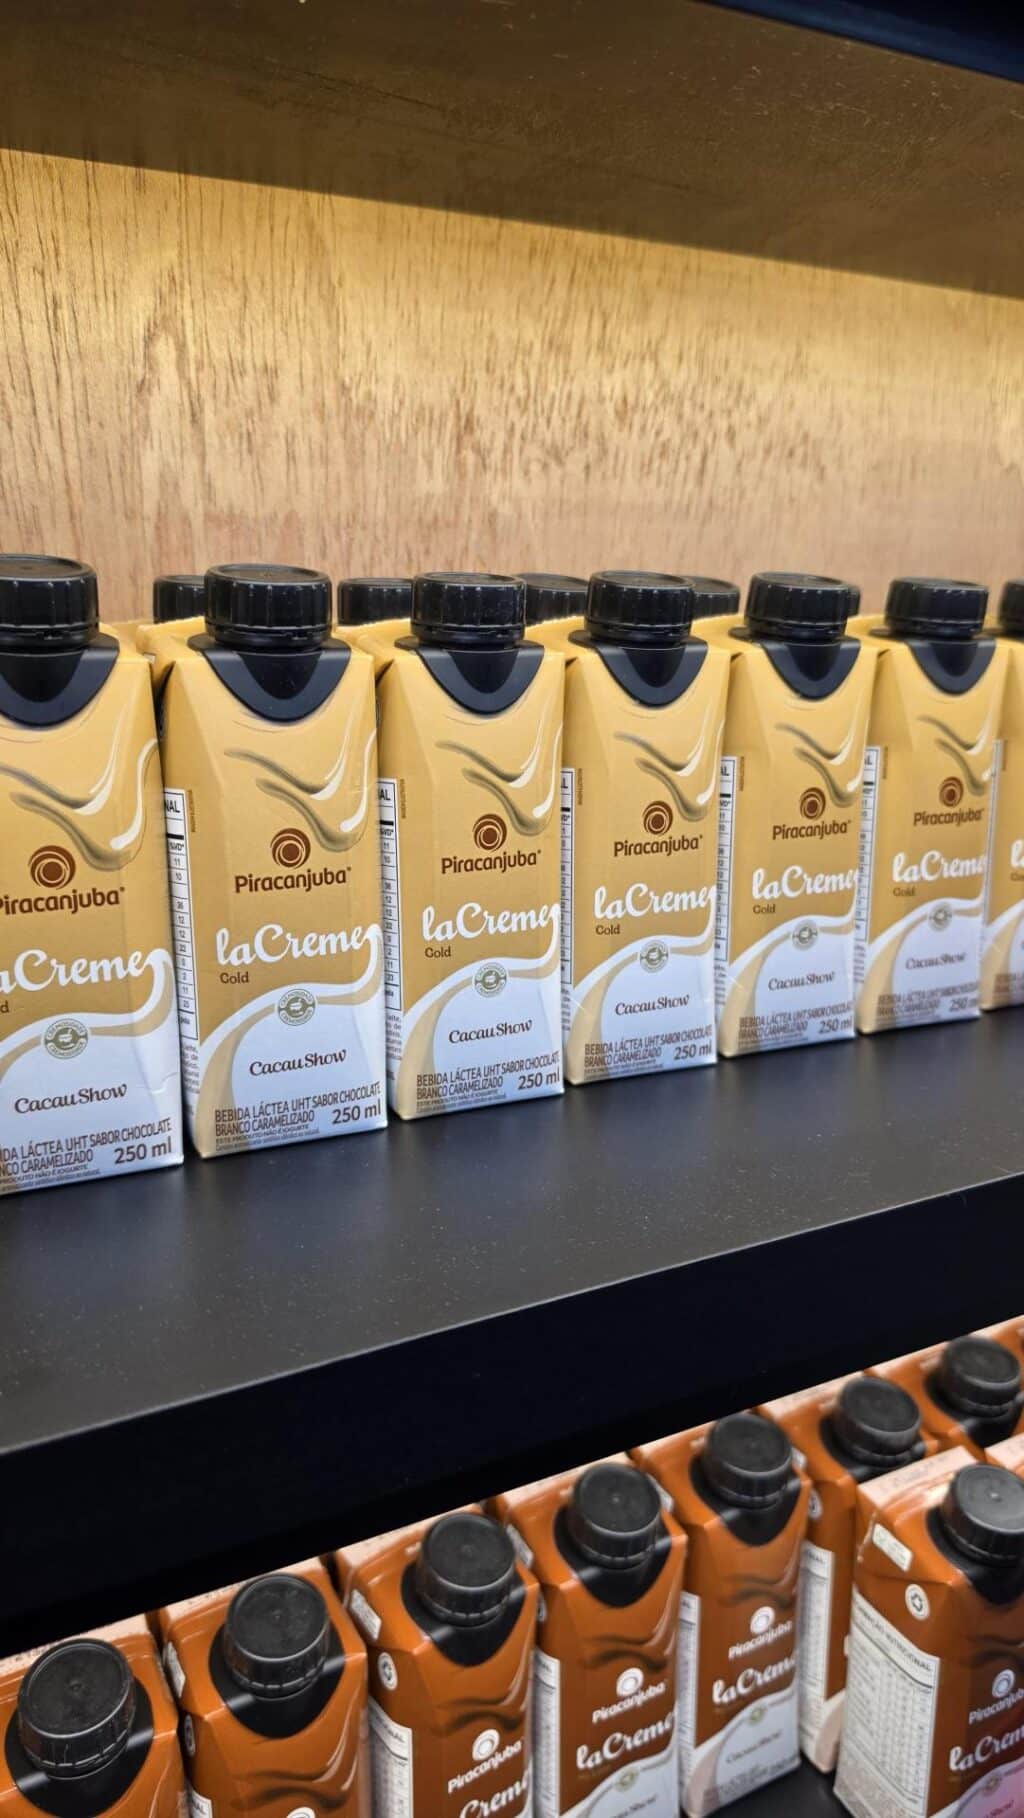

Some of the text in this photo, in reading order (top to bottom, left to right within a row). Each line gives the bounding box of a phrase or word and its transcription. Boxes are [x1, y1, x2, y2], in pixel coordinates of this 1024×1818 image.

[772, 820, 848, 840] Piracanjuba
[613, 834, 699, 857] Piracanjuba
[441, 850, 537, 874] Piracanjuba
[235, 868, 347, 893] Piracanjuba
[0, 887, 120, 915] iracanjuba
[594, 883, 709, 919] laCreme
[753, 904, 775, 914] Gold
[422, 902, 551, 941] laCreme
[595, 924, 620, 935] Gold
[216, 924, 364, 966] laCreme
[424, 946, 451, 958] Gold
[220, 972, 249, 984] Gold
[818, 1019, 840, 1034] 250
[584, 1042, 613, 1056] BEBIDA
[674, 1044, 696, 1061] 250
[416, 1072, 448, 1087] BEBIDA
[450, 1066, 482, 1083] LÁCTEA
[483, 1063, 501, 1077] UHT
[501, 1059, 525, 1073] SABOR
[518, 1066, 560, 1090] 250 ml
[416, 1076, 503, 1099] BRANCO CARAMELIZADO
[215, 1081, 381, 1122] BEBIDA LÁCTEA UHT SABOR CHOCOLATE
[332, 1099, 381, 1125] 250 ml
[215, 1111, 315, 1137] BRANCO CARAMELIZADO
[21, 1139, 63, 1159] LÁCTEA
[65, 1134, 88, 1151] UHT
[90, 1129, 120, 1147] SABOR
[121, 1118, 172, 1142] CHOCOLATE
[114, 1136, 172, 1165] 250 ml
[21, 1149, 94, 1173] CARAMELIZADO
[968, 1688, 1024, 1725] Piracanjub
[949, 1725, 1024, 1771] laCrem
